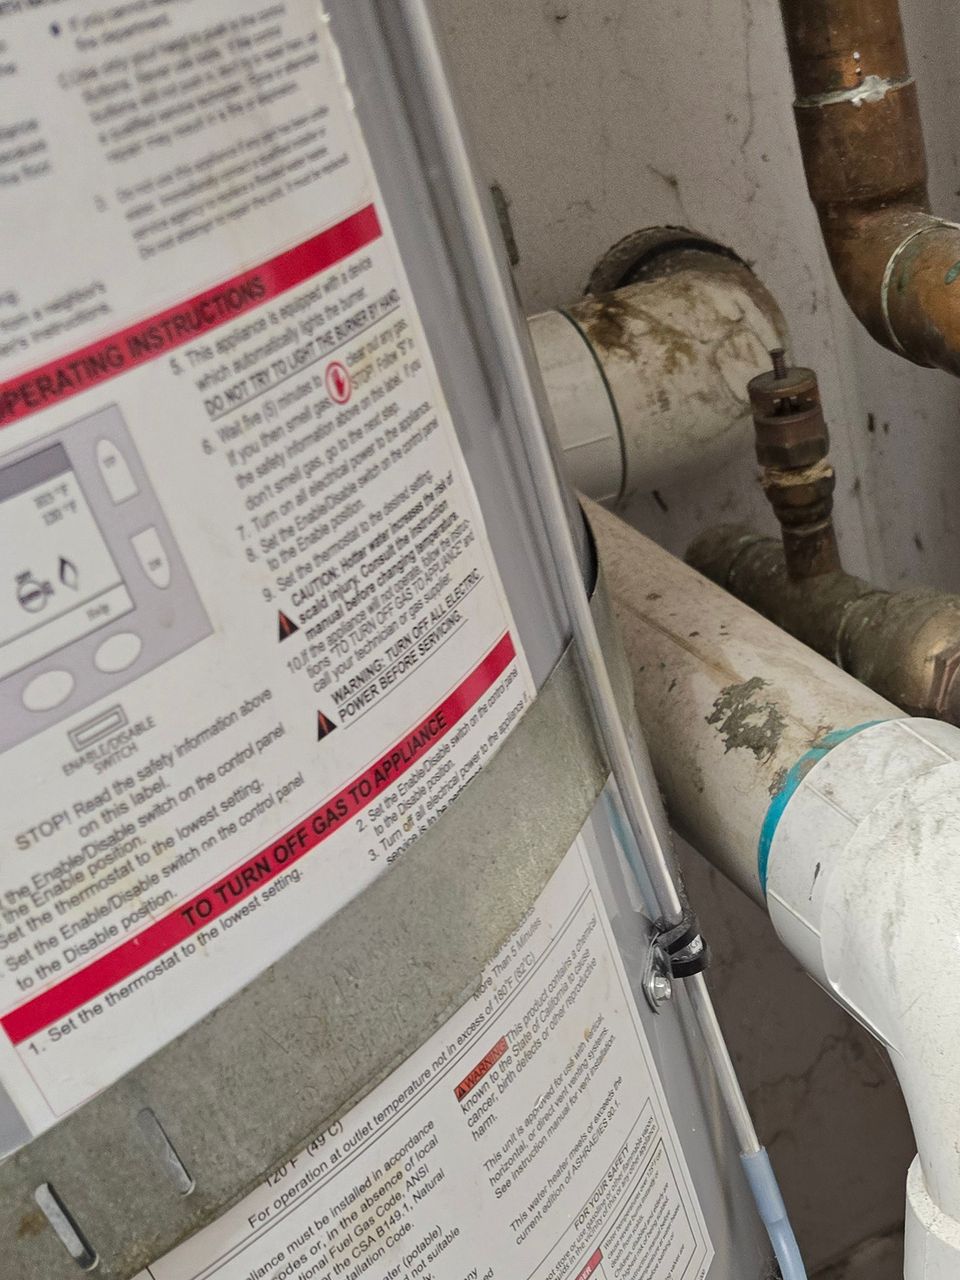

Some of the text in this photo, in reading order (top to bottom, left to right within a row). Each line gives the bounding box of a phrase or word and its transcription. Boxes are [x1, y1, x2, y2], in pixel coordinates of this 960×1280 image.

[0, 347, 125, 420] PERATING
[330, 567, 480, 705] WARNING: TURN OFF ALL ELECTRIC
[338, 683, 380, 723] POWER
[378, 649, 419, 691] BEFORE
[15, 688, 273, 851] STOP! Read the safety information above
[180, 709, 448, 927] TO TURN OFF GAS TO APPLIANCE
[25, 911, 54, 933] the
[53, 859, 136, 916] thermostat
[133, 851, 152, 867] to
[151, 836, 176, 857] the
[174, 804, 220, 841] lowest
[15, 976, 35, 992] to
[34, 959, 62, 981] the
[61, 924, 120, 964] Disable
[47, 1017, 78, 1042] Set
[77, 1003, 104, 1024] the
[103, 950, 182, 1008] thermostat
[180, 942, 197, 958] to
[196, 927, 220, 947] the
[218, 895, 262, 931] lowest
[465, 1038, 508, 1094] WARNING
[286, 1225, 316, 1255] must
[313, 1215, 330, 1231] be
[329, 1175, 373, 1218] installed
[371, 1168, 384, 1182] in
[383, 1120, 434, 1172] accordance
[309, 1240, 327, 1256] or,
[325, 1228, 339, 1242] in
[339, 1211, 359, 1230] the
[359, 1170, 404, 1213] absence
[404, 1155, 416, 1173] of
[414, 1134, 439, 1162] local
[328, 1232, 354, 1260] Fuel
[353, 1215, 376, 1237] Gas
[405, 1163, 430, 1193] ANSI
[332, 1257, 351, 1276] the
[351, 1235, 377, 1259] CSA
[412, 1167, 446, 1204] Natural
[402, 1224, 443, 1269] (potable)
